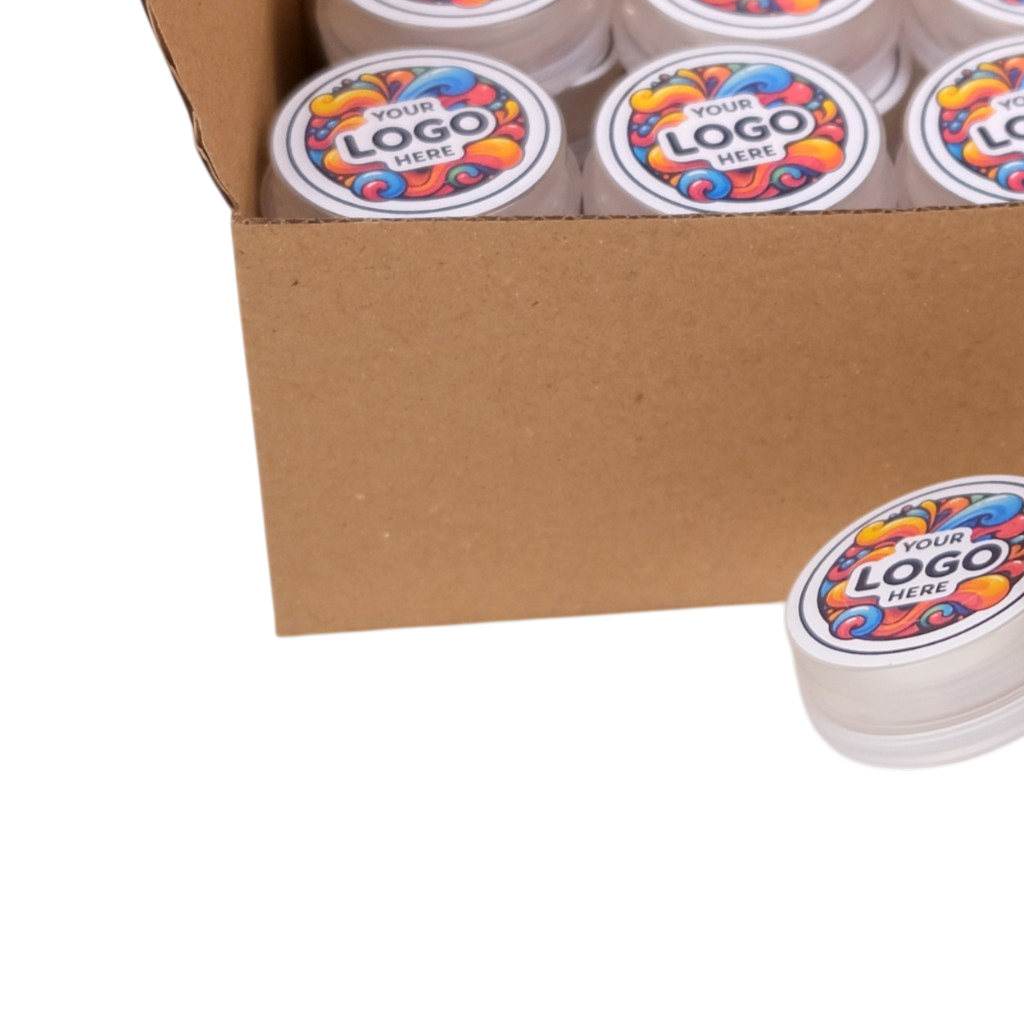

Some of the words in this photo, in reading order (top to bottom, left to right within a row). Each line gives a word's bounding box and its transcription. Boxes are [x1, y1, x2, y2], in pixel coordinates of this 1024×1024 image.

[371, 102, 435, 122] YOUR
[690, 99, 753, 118] YOUR
[344, 110, 489, 158] LOGO
[665, 109, 807, 156] LOGO
[394, 145, 455, 167] HERE
[717, 145, 777, 166] HERE
[902, 532, 965, 553] YOUR
[854, 543, 1003, 592] LOGO
[888, 580, 950, 602] HERE
